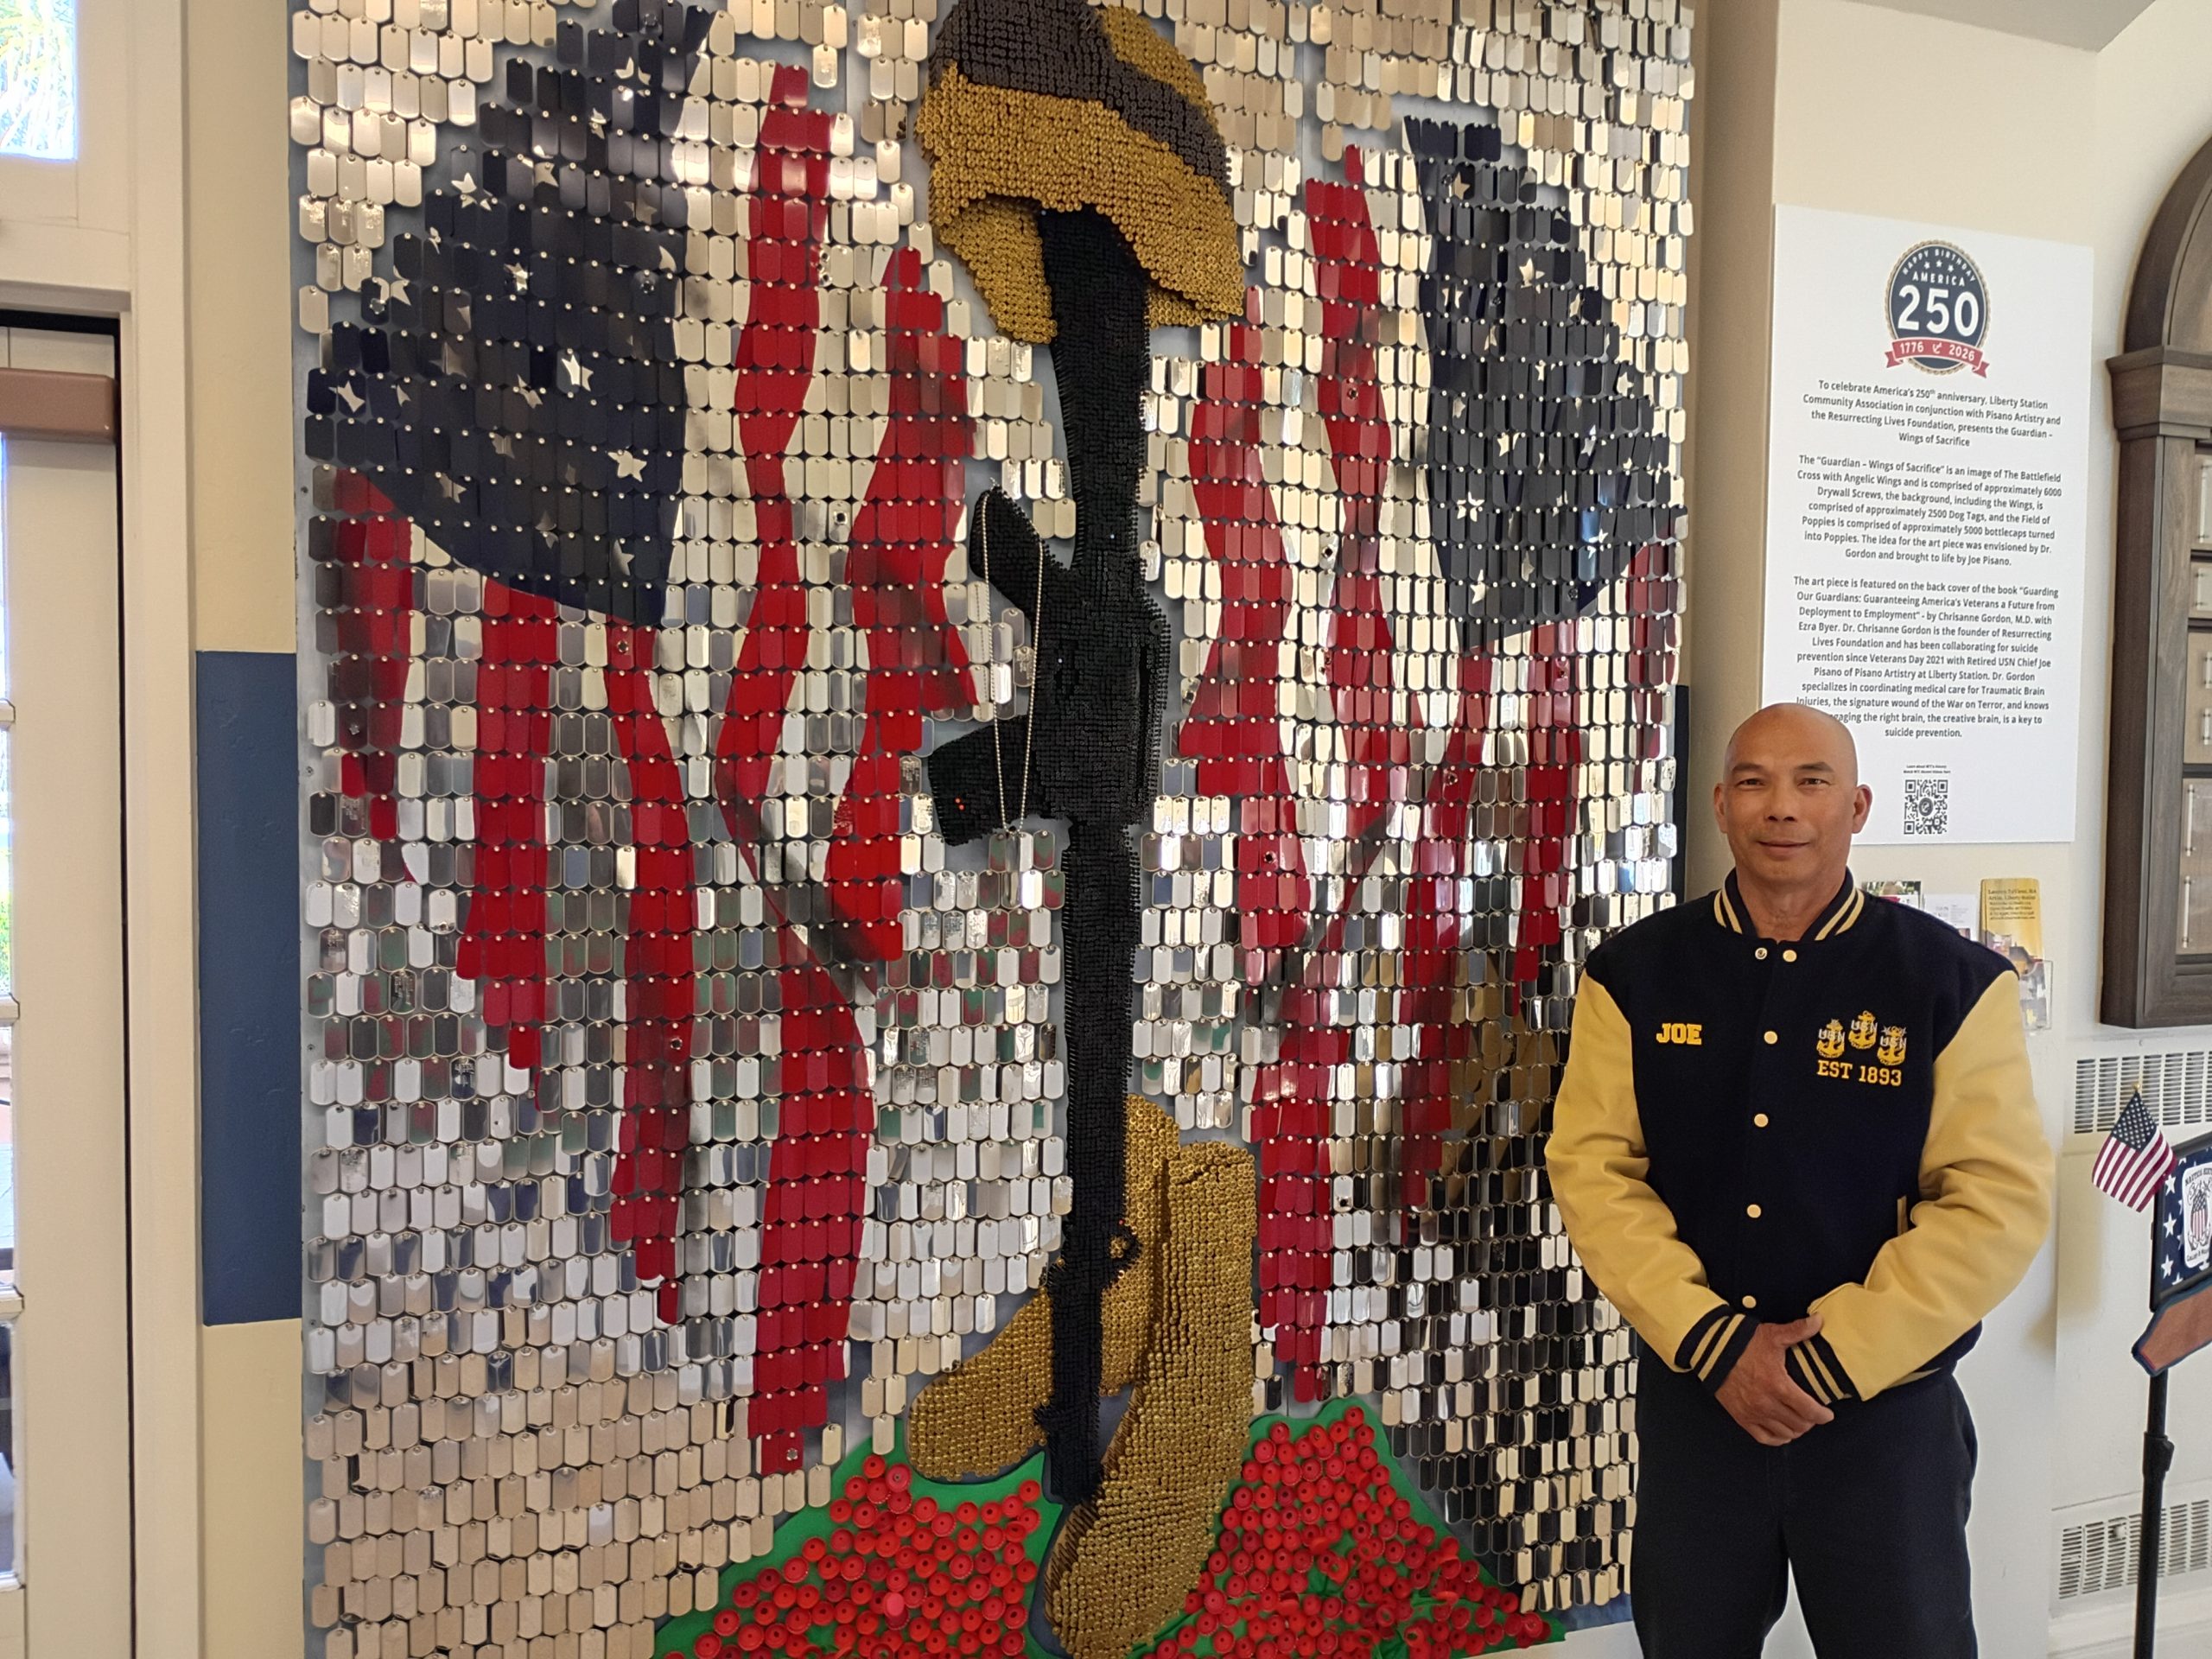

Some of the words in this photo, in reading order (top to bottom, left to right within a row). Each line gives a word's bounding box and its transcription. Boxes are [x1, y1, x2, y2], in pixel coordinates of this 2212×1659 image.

[1903, 250, 1929, 275] HAPPY
[1935, 249, 1976, 282] BIRTHDAY
[1912, 270, 1965, 287] AMERICA
[1897, 284, 1980, 337] 250
[1900, 341, 1924, 354] 1776
[1948, 344, 1975, 361] 2026
[1818, 379, 1829, 389] To
[1830, 381, 1872, 393] celebrate
[1936, 391, 1987, 405] anniversary,
[1989, 395, 2018, 409] Liberty
[2019, 398, 2048, 409] Station
[1802, 393, 1853, 409] Community
[1854, 398, 1904, 410] Association
[1905, 403, 1913, 411] in
[1915, 404, 1963, 416] conjunction
[1965, 408, 1984, 417] with
[1986, 410, 2012, 421] Pisano
[2013, 412, 2044, 425] Artistry
[2045, 416, 2061, 424] and
[1811, 410, 1826, 419] the
[1827, 410, 1882, 427] Resurrecting
[1884, 416, 1905, 426] Lives
[1907, 417, 1956, 431] Foundation,
[1957, 424, 1993, 433] presents
[1995, 425, 2008, 435] the
[2011, 427, 2047, 437] Guardian
[1898, 432, 1923, 444] Wings
[1925, 434, 1934, 442] of
[1936, 435, 1970, 446] Sacrifice
[1797, 469, 1821, 480] Cross
[1822, 472, 1842, 481] with
[1843, 473, 1875, 485] Angelic
[1876, 474, 1902, 487] Wings
[1903, 478, 1919, 486] and
[1921, 478, 1928, 487] is
[1929, 480, 1972, 491] comprised
[1974, 482, 1983, 491] of
[1984, 484, 2043, 498] approximately
[2044, 487, 2062, 496] 6000
[1817, 486, 1850, 498] Drywall
[1852, 488, 1883, 500] Screws,
[1885, 490, 1899, 500] the
[1901, 492, 1952, 505] background,
[1954, 495, 1992, 509] including
[1993, 498, 2007, 507] the
[2008, 499, 2035, 511] Wings,
[2036, 500, 2043, 510] is
[1808, 502, 1853, 513] comprised
[1855, 504, 1865, 512] of
[1866, 505, 1926, 519] approximately
[1928, 508, 1947, 518] 2500
[1948, 510, 1965, 522] Dog
[1966, 511, 1986, 523] Tags,
[1988, 512, 2004, 521] and
[2005, 513, 2020, 523] the
[2021, 514, 2040, 524] Field
[2041, 515, 2050, 524] of
[1802, 515, 1835, 528] Poppies
[1837, 517, 1844, 527] is
[1846, 519, 1891, 531] comprised
[1891, 520, 1901, 530] of
[1902, 523, 1962, 536] approximately
[1963, 525, 1982, 535] 5000
[1984, 526, 2027, 539] bottlecaps
[2028, 530, 2055, 539] turned
[1796, 591, 1814, 600] Our
[1815, 591, 1861, 602] Guardians:
[1863, 594, 1920, 607] Guaranteeing
[1962, 598, 1999, 608] Veterans
[2007, 600, 2034, 609] Future
[2036, 601, 2055, 610] from
[1799, 606, 1851, 619] Deployment
[1926, 610, 1936, 622] by
[1938, 612, 1979, 621] Chrisanne
[1980, 613, 2012, 623] Gordon,
[2015, 614, 2032, 624] M.D.
[2034, 615, 2051, 625] with
[1798, 621, 1816, 631] Ezra
[1818, 622, 1840, 633] Byer.
[1842, 622, 1855, 632] Dr.
[1857, 623, 1899, 633] Chrisanne
[1901, 625, 1931, 634] Gordon
[1933, 626, 1940, 635] is
[1942, 626, 1955, 635] the
[1957, 626, 1990, 636] founder
[1991, 628, 2000, 637] of
[2001, 628, 2051, 641] Resurrecting
[1812, 636, 1834, 646] Lives
[1835, 637, 1884, 647] Foundation
[1885, 639, 1901, 648] and
[1904, 639, 1918, 649] has
[1920, 639, 1940, 649] been
[1942, 641, 1995, 653] collaborating
[1997, 642, 2009, 652] for
[2011, 643, 2038, 652] suicide
[1796, 652, 1844, 663] prevention
[1846, 652, 1867, 662] since
[1869, 653, 1906, 664] Veterans
[1908, 655, 1924, 665] Day
[1926, 655, 1944, 664] 2021
[1946, 656, 1965, 664] with
[1967, 656, 1996, 665] Retired
[1998, 657, 2015, 666] USN
[2017, 658, 2037, 667] Chief
[2037, 658, 2051, 669] Joe
[1814, 666, 1842, 676] Pisano
[1843, 667, 1853, 676] of
[1854, 667, 1882, 677] Pisano
[1884, 669, 1916, 680] Artistry
[1928, 670, 1957, 681] Liberty
[1958, 671, 1990, 680] Station.
[1992, 671, 2004, 680] Dr.
[2005, 671, 2035, 681] Gordon
[1802, 681, 1847, 692] specializes
[1849, 682, 1858, 691] in
[1859, 683, 1912, 695] coordinating
[1914, 683, 1946, 693] medical
[1967, 684, 1980, 694] for
[1981, 685, 2022, 695] Traumatic
[2024, 686, 2044, 695] Brain
[1833, 696, 1847, 706] the
[1849, 697, 1889, 709] signature
[1891, 698, 1919, 707] wound
[1921, 698, 1930, 707] of
[1931, 698, 1945, 708] the
[1946, 699, 1963, 708] War
[1977, 700, 2005, 709] Terror,
[2006, 700, 2022, 709] and
[2024, 700, 2049, 709] knows
[1885, 727, 1914, 736] suicide
[1915, 728, 1962, 739] prevention.
[1656, 1023, 1702, 1046] JOE
[1851, 1020, 1878, 1037] USN
[1816, 1059, 1853, 1079] EST
[1858, 1065, 1902, 1087] 1893
